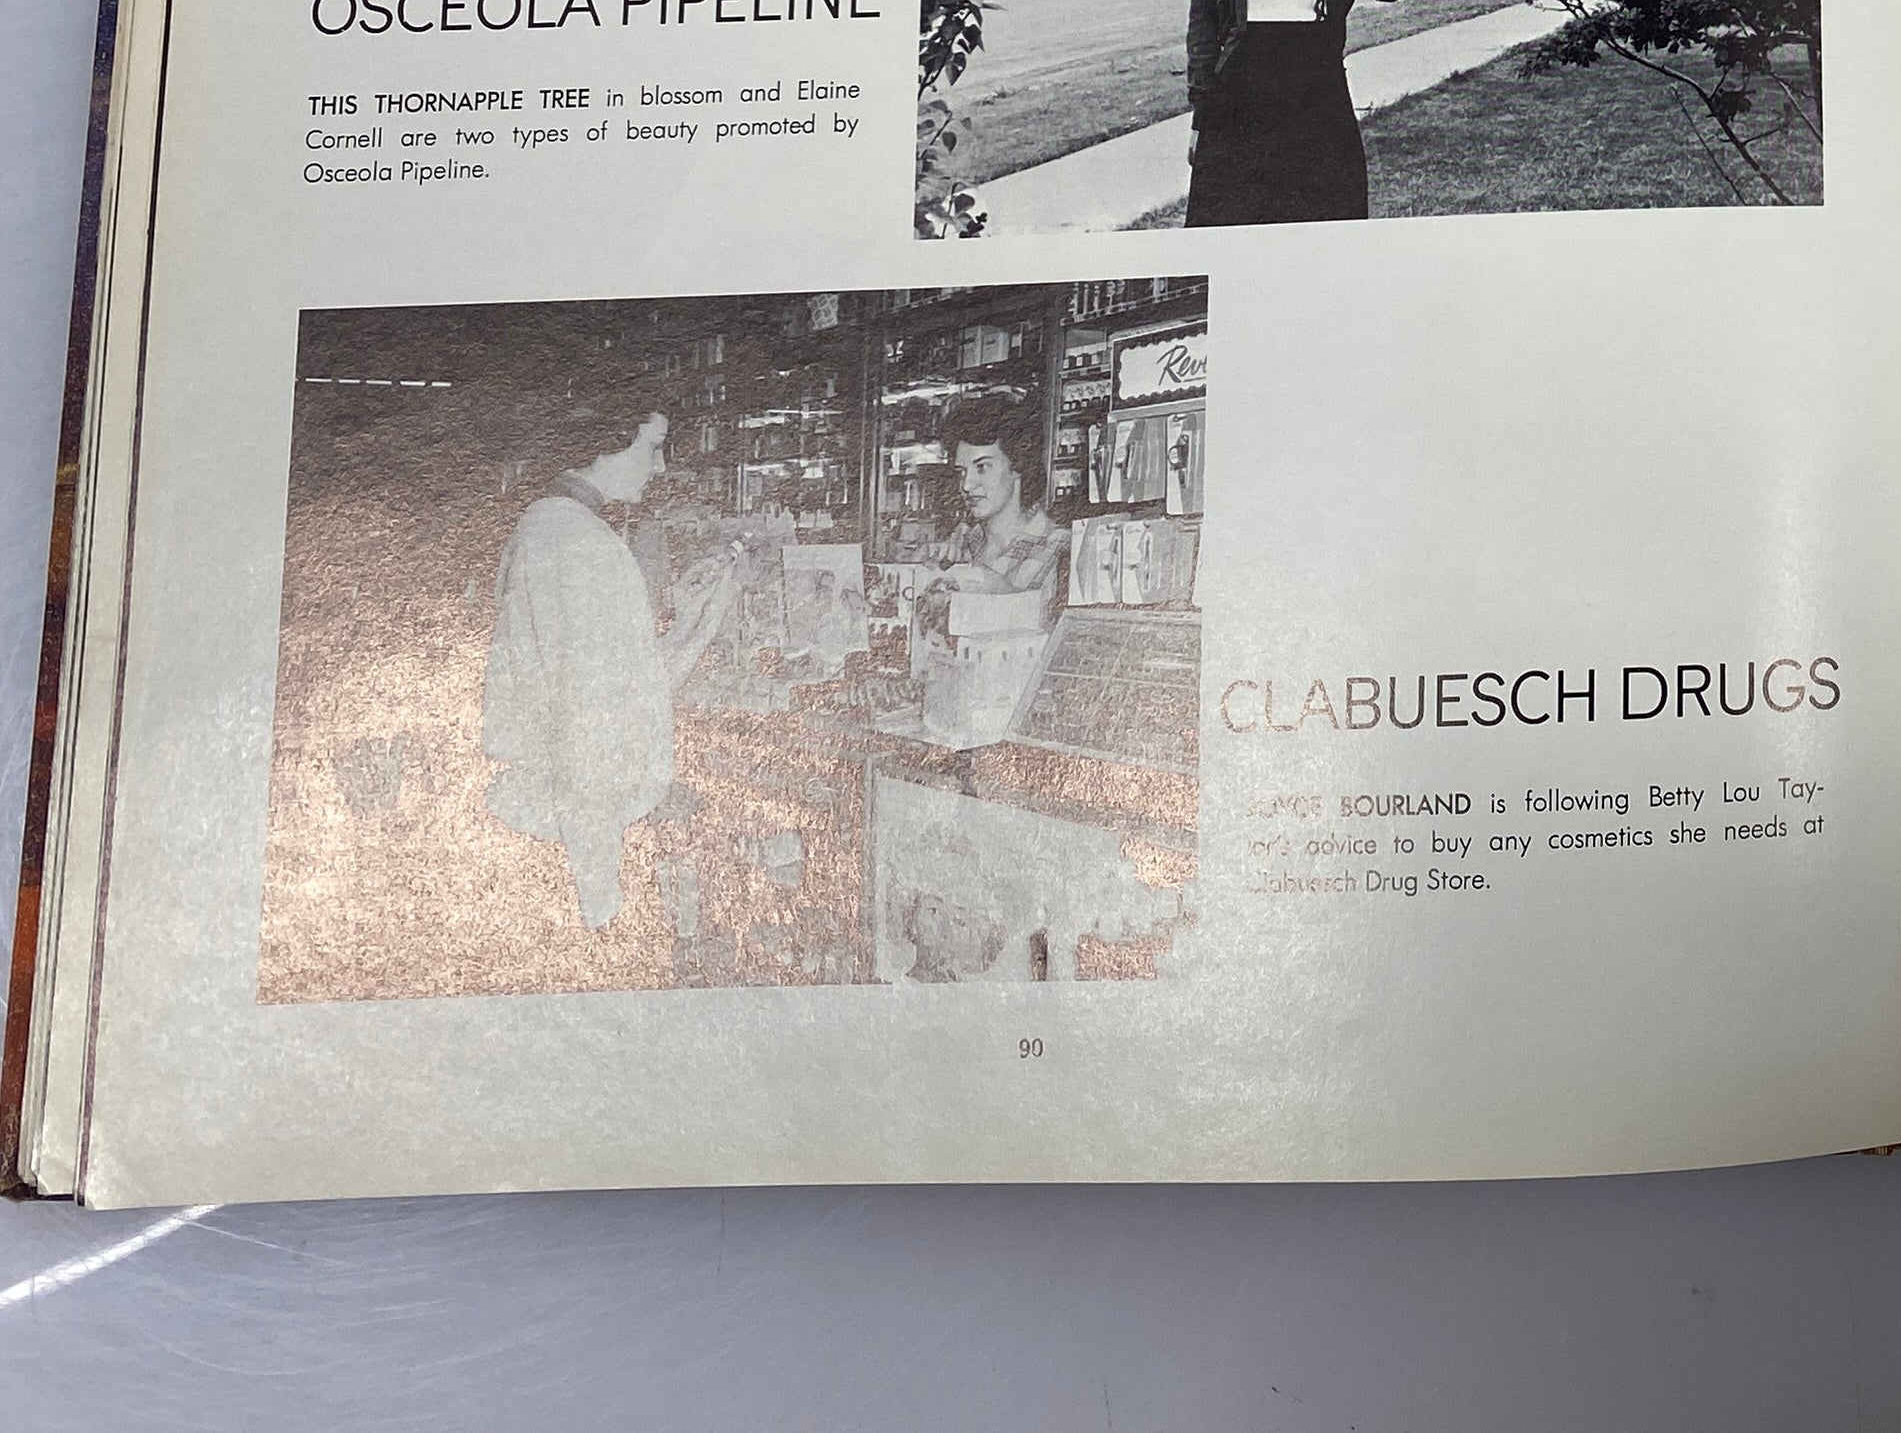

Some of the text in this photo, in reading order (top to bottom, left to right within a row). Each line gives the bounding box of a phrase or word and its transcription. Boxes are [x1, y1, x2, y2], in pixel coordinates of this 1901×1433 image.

[307, 79, 860, 116] THIS THORNAPPLE TREE in blossom and Elaine
[305, 111, 860, 150] Cornell are two types of beauty promoted by
[303, 158, 490, 186] Osceola Pipeline.
[1220, 656, 1841, 734] CLABUESCH DRUGS
[1341, 792, 1472, 817] BOURLAND
[1490, 793, 1506, 814] is
[1524, 787, 1629, 816] following
[1649, 785, 1705, 812] Betty
[1723, 781, 1760, 803] Lou
[1777, 777, 1825, 804] Tay-
[1303, 831, 1378, 856] advice
[1393, 835, 1415, 854] to
[1431, 829, 1472, 859] buy
[1489, 835, 1532, 858] any
[1548, 825, 1653, 850] cosmetics
[1669, 820, 1706, 844] she
[1724, 814, 1788, 841] needs
[1803, 814, 1825, 835] at
[1366, 869, 1418, 897] Drug
[1426, 868, 1491, 891] Store.
[1019, 1038, 1043, 1058] 90
